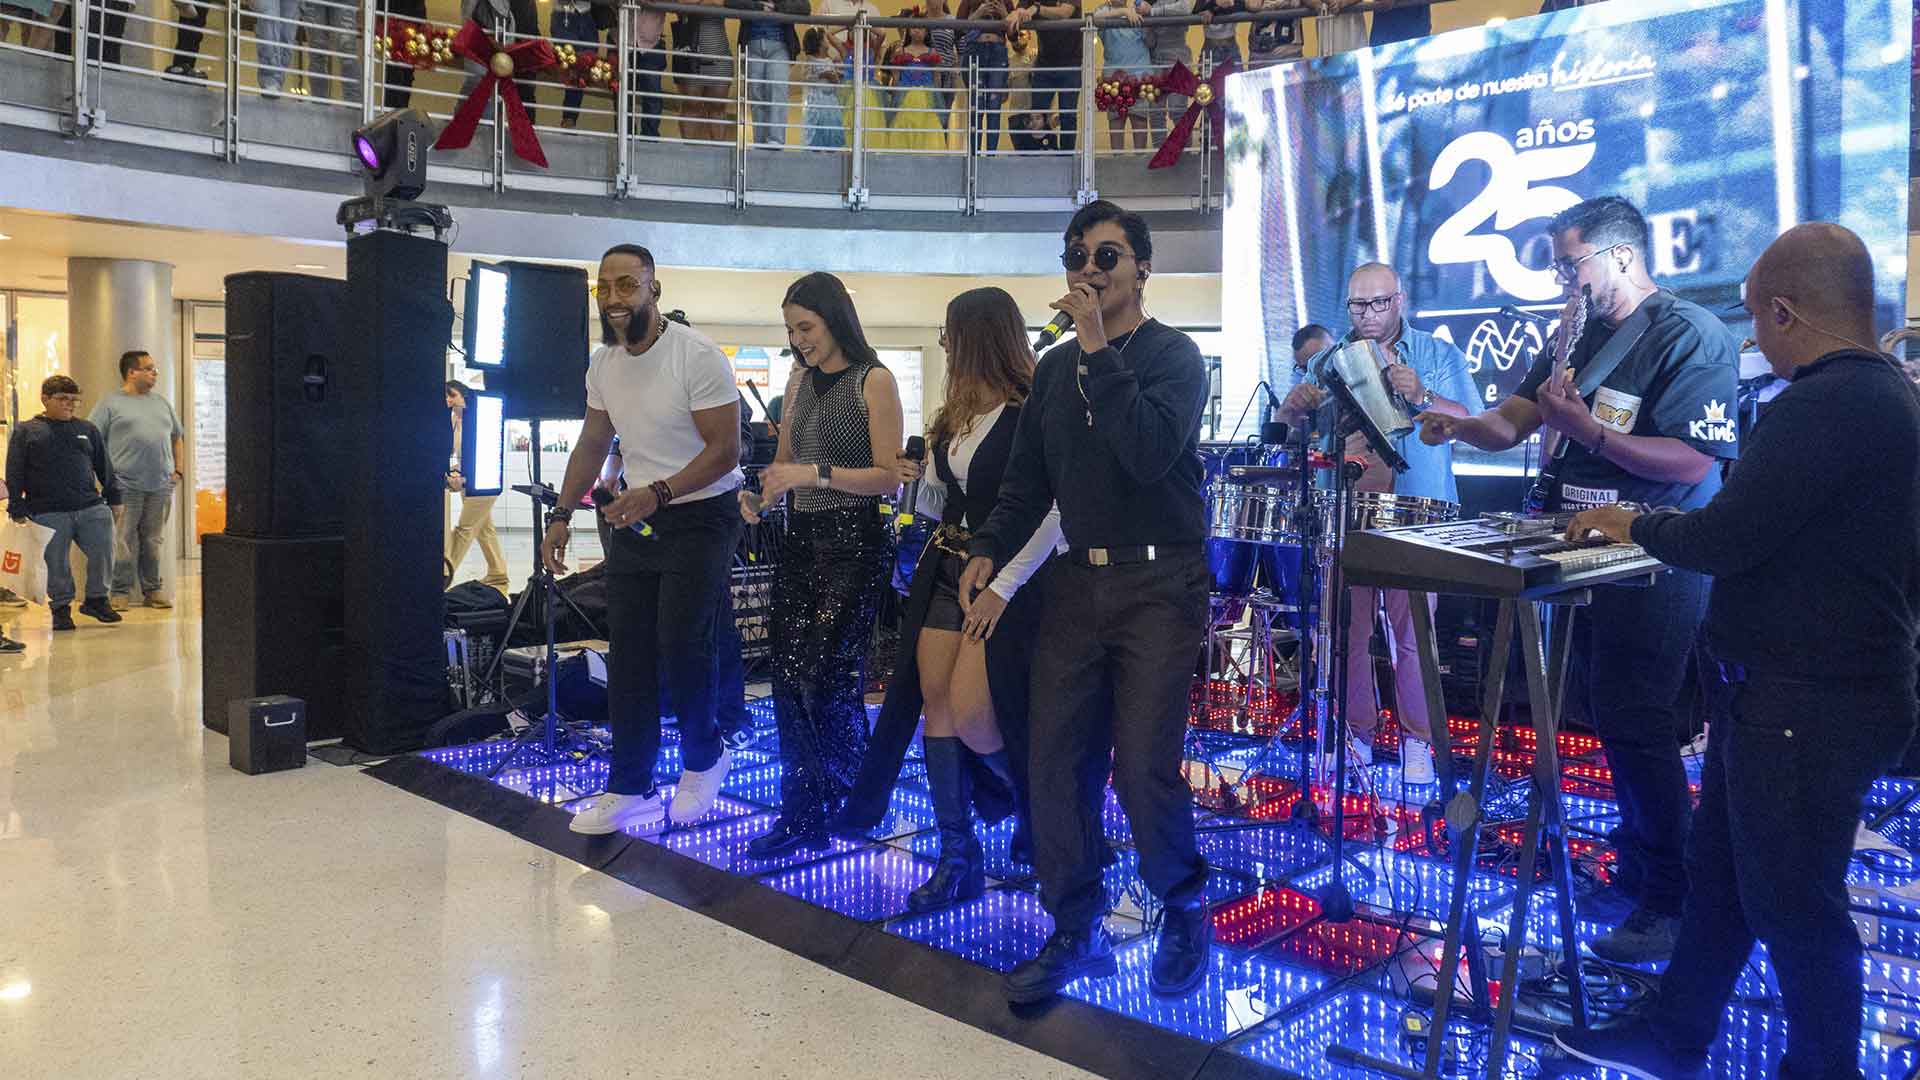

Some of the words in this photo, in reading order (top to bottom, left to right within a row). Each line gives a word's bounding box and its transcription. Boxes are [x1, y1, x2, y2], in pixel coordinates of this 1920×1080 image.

[1408, 87, 1452, 111] parte
[1455, 81, 1480, 101] de
[1516, 117, 1596, 148] años
[1428, 131, 1596, 302] 25
[1564, 486, 1613, 502] ORIGINAL
